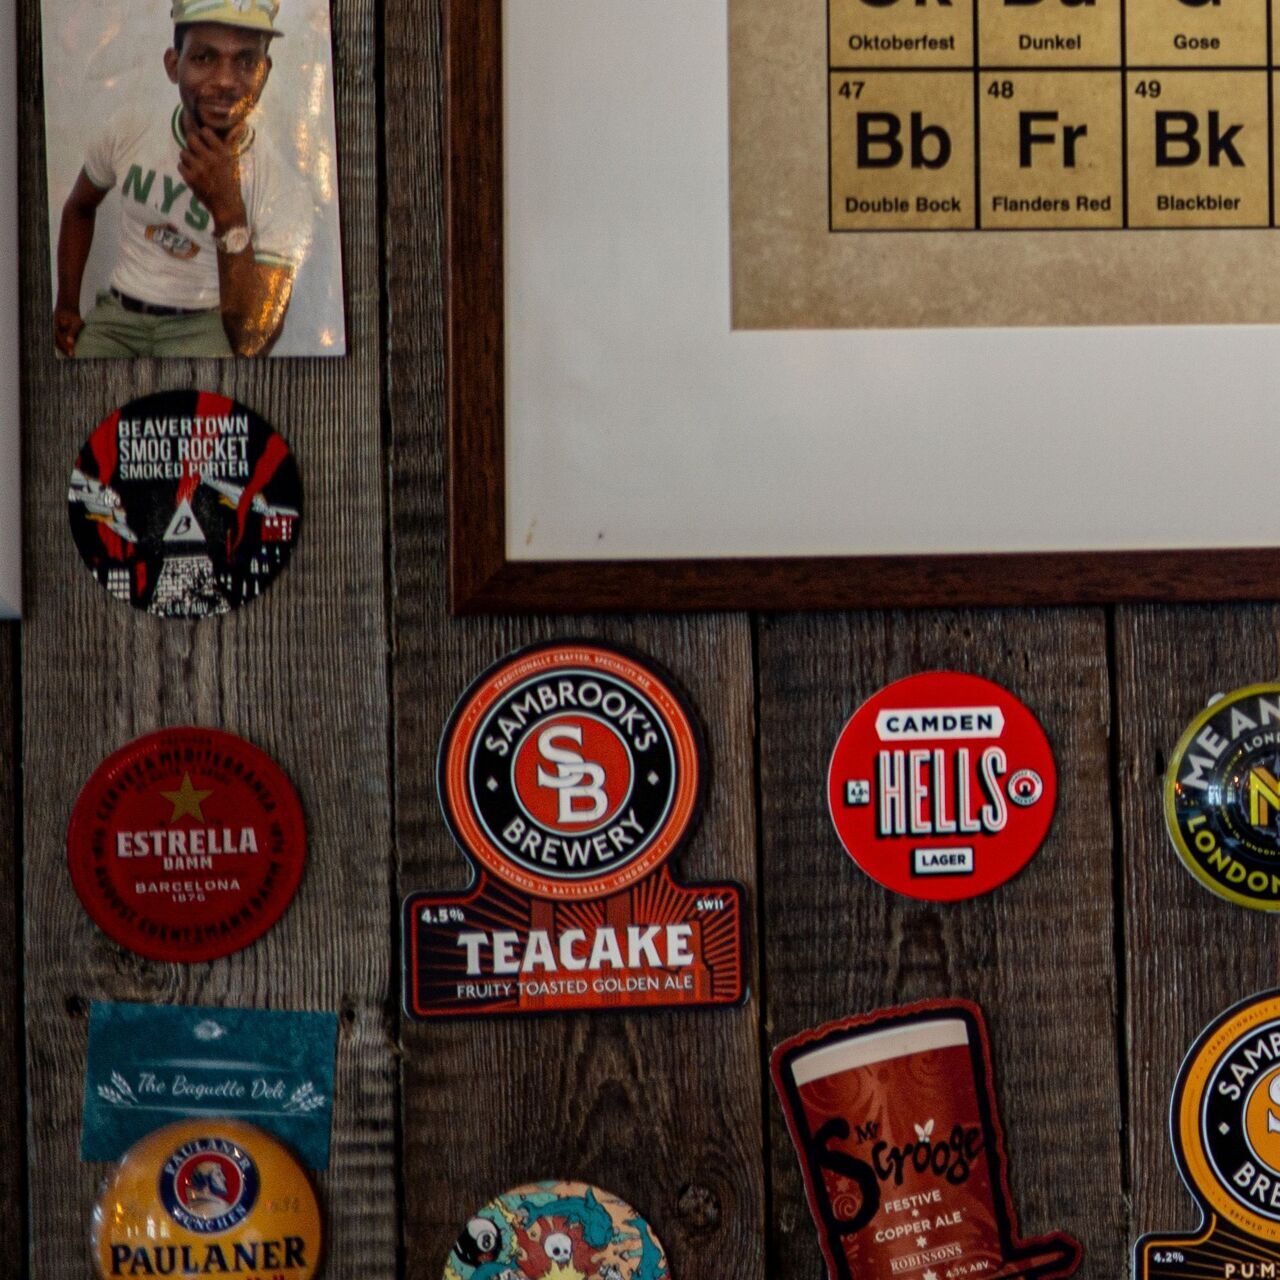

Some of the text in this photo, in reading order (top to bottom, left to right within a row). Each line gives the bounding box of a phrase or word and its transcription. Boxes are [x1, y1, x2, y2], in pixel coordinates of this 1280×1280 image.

[856, 111, 951, 170] Bb
[1019, 110, 1087, 168] Fr
[1155, 110, 1245, 168] Bk
[118, 416, 249, 437] BEAVERTOWN
[120, 437, 249, 462] SMOG ROCKET
[120, 461, 249, 480] SMOKED PORTER
[485, 681, 658, 756] SAMBROOK'S
[887, 714, 993, 733] CAMDEN
[878, 746, 1007, 836] HELLS
[117, 827, 258, 857] ESTRELLA
[502, 808, 645, 866] BREWERY
[163, 857, 213, 871] DAMM
[922, 854, 966, 866] LAGER
[135, 880, 240, 894] BARCELONA
[456, 924, 694, 975] TEACAKE
[457, 975, 693, 999] FRUITY TOASTED GOLDEN ALE
[138, 1073, 285, 1100] The Baguette Deli
[884, 1190, 942, 1213] FESTIVE
[875, 1210, 962, 1243] COPPER ALE
[110, 1236, 306, 1276] PAULANER
